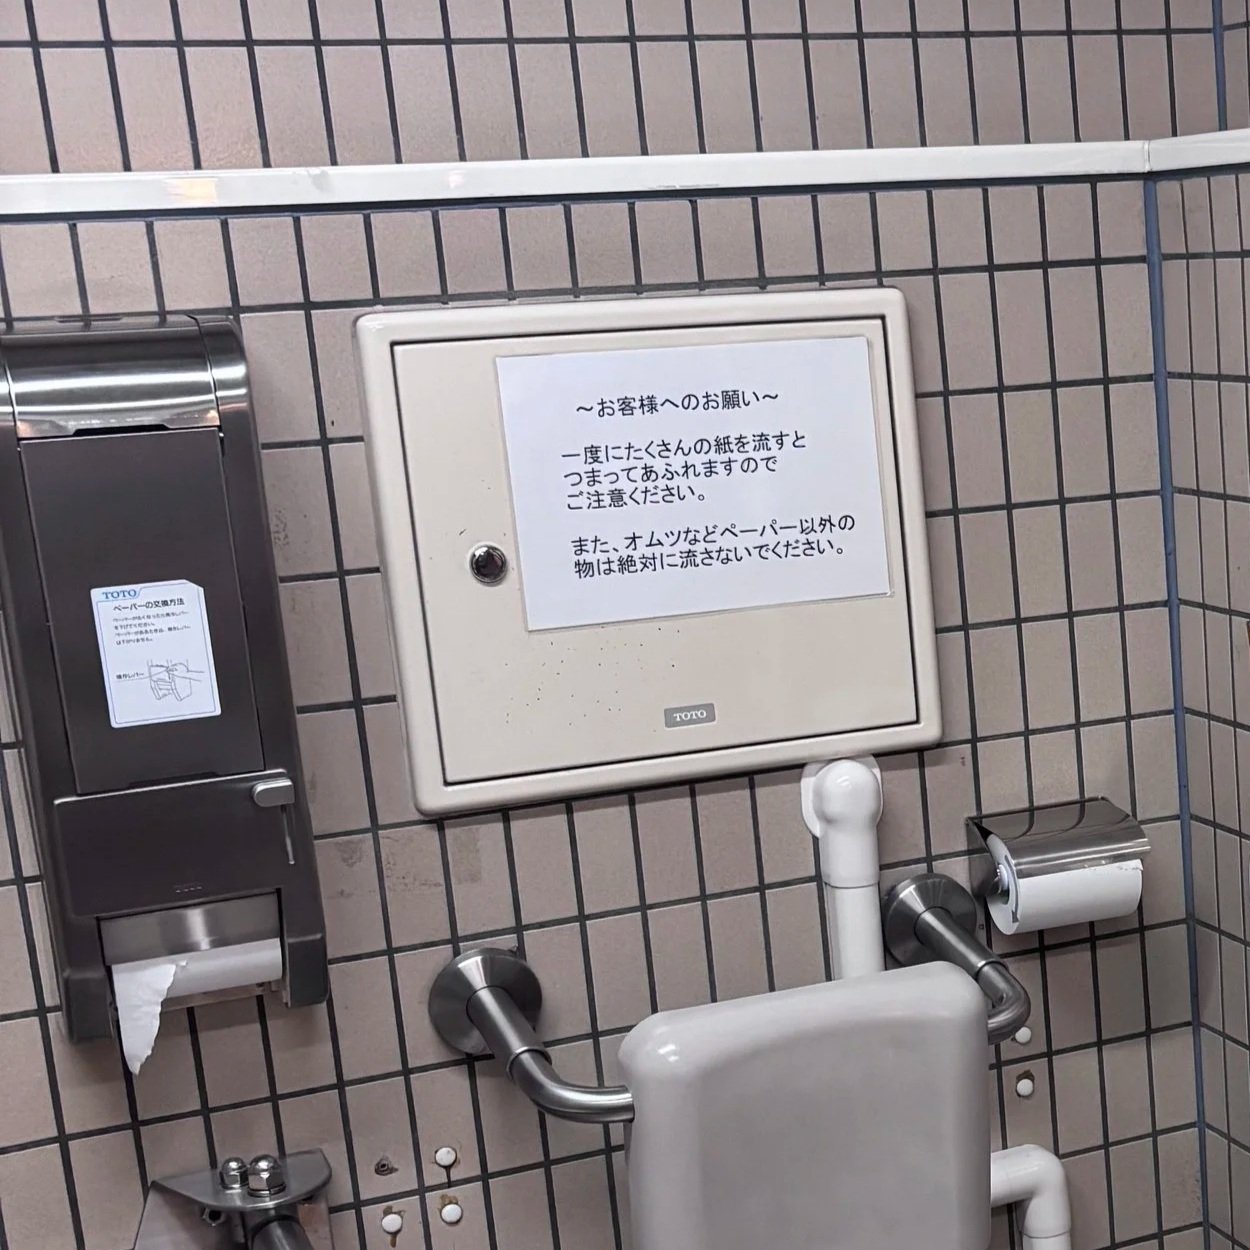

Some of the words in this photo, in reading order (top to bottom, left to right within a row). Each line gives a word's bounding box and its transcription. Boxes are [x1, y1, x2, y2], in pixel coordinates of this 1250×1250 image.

[562, 430, 806, 465] 一度にたくさんの紙を流すと
[564, 455, 777, 487] つまってあふれますので
[567, 484, 706, 511] ご注意ください。
[571, 514, 855, 556] また、オムツなどペーパー以外の
[575, 537, 844, 580] 物は絶対に流さないでください。
[102, 589, 137, 600] TOTO
[673, 709, 707, 721] TOTO
